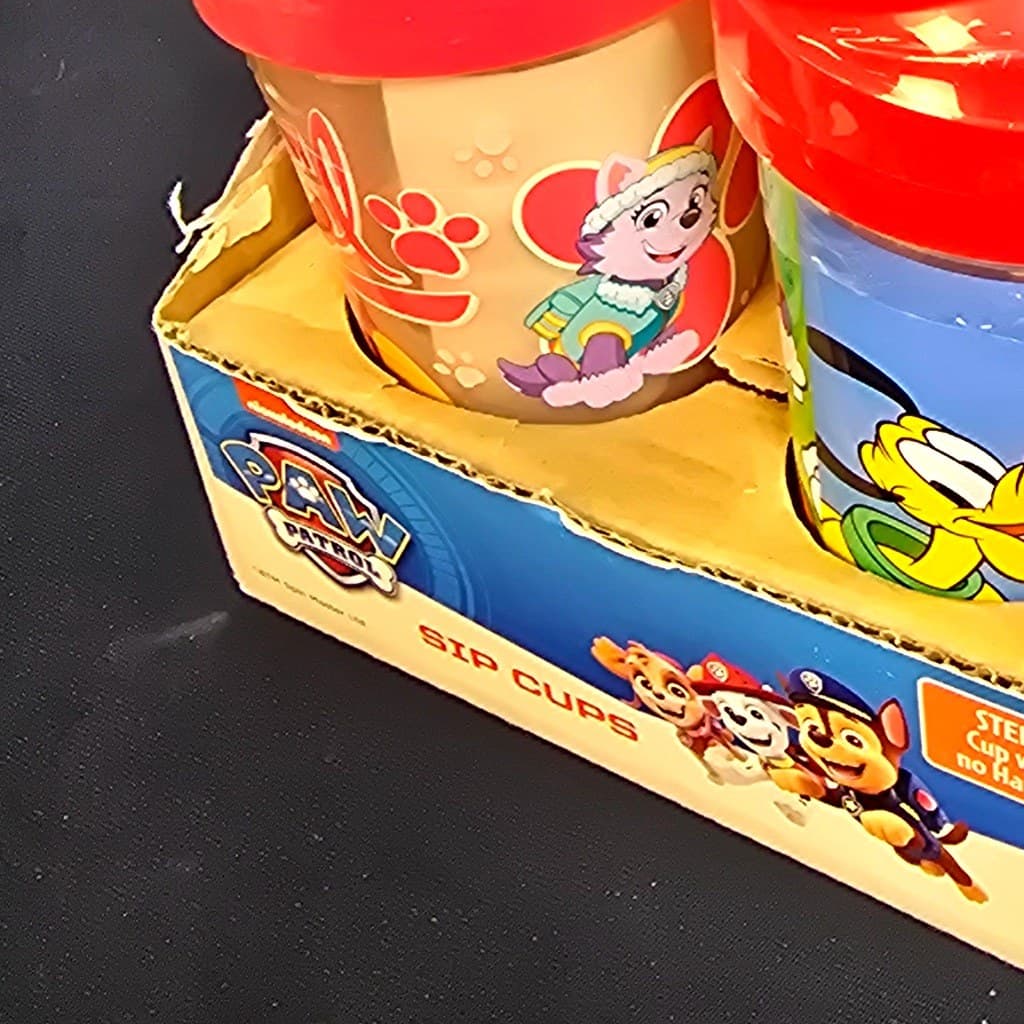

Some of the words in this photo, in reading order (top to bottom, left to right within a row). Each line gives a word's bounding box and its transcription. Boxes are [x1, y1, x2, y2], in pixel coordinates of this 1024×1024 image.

[219, 438, 411, 566] PAW
[283, 520, 384, 581] PATROL
[418, 623, 499, 673] SIP
[511, 667, 640, 742] CUPS
[956, 752, 987, 775] no
[966, 729, 1010, 764] Cup
